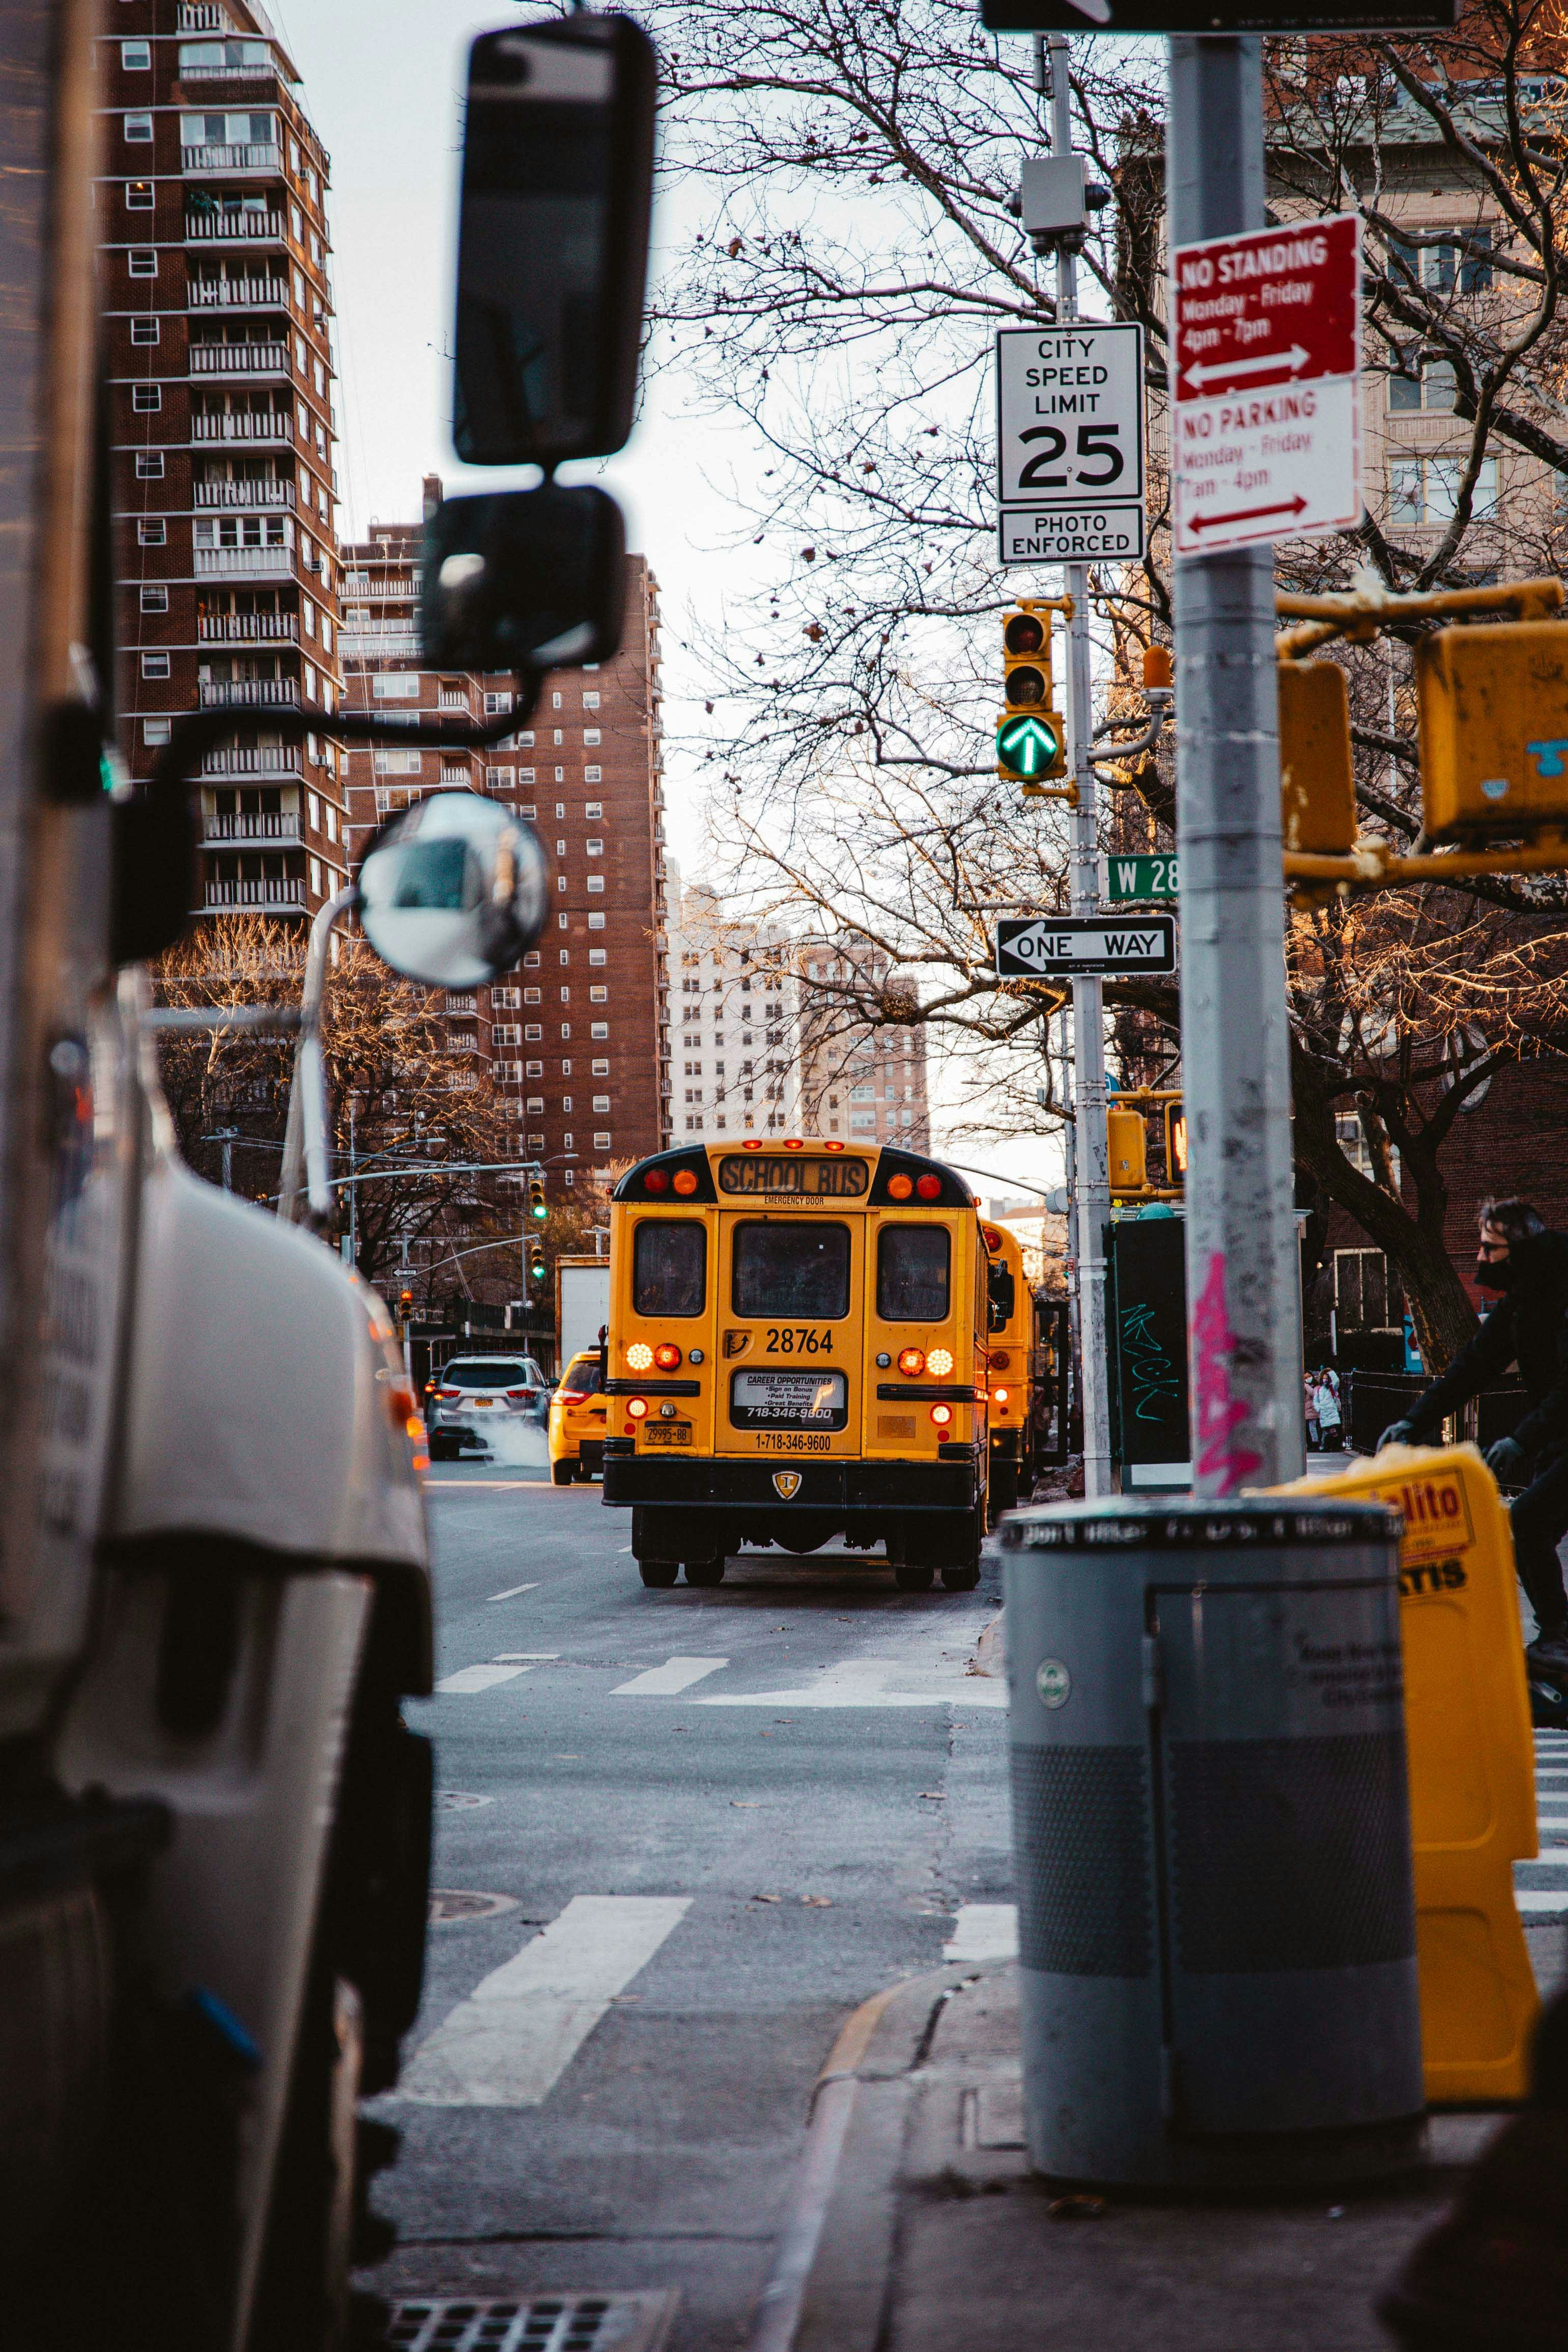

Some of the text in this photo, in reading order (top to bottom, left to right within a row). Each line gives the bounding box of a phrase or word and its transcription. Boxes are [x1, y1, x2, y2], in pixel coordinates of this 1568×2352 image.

[1182, 235, 1328, 290] NO STANDING
[1182, 292, 1247, 322] Monday
[1261, 280, 1315, 307] Friday
[1183, 327, 1221, 354] 4pm
[1234, 317, 1271, 345] 7pm
[1038, 338, 1095, 359] CITY
[1025, 366, 1107, 387] SPEED
[1035, 394, 1100, 414] LIMIT
[1184, 390, 1316, 440] NO PARKING
[1018, 424, 1124, 488] 25
[1184, 446, 1243, 469] Monday
[1261, 432, 1312, 456] Friday
[1234, 468, 1268, 492] 4pm
[1035, 515, 1106, 533] PHOTO
[1013, 534, 1129, 554] ENFORCED
[1118, 860, 1179, 893] W 28
[1017, 933, 1158, 957] ONE WAY
[724, 1159, 861, 1194] SCHOOL BUS
[764, 1196, 824, 1205] EMERGENCY DOOR
[765, 1328, 833, 1353] 28764
[747, 1376, 832, 1385] CAREER OPPORTUNITIES
[747, 1407, 832, 1418] 718-346-9600
[756, 1434, 831, 1450] 1-718-346-9600
